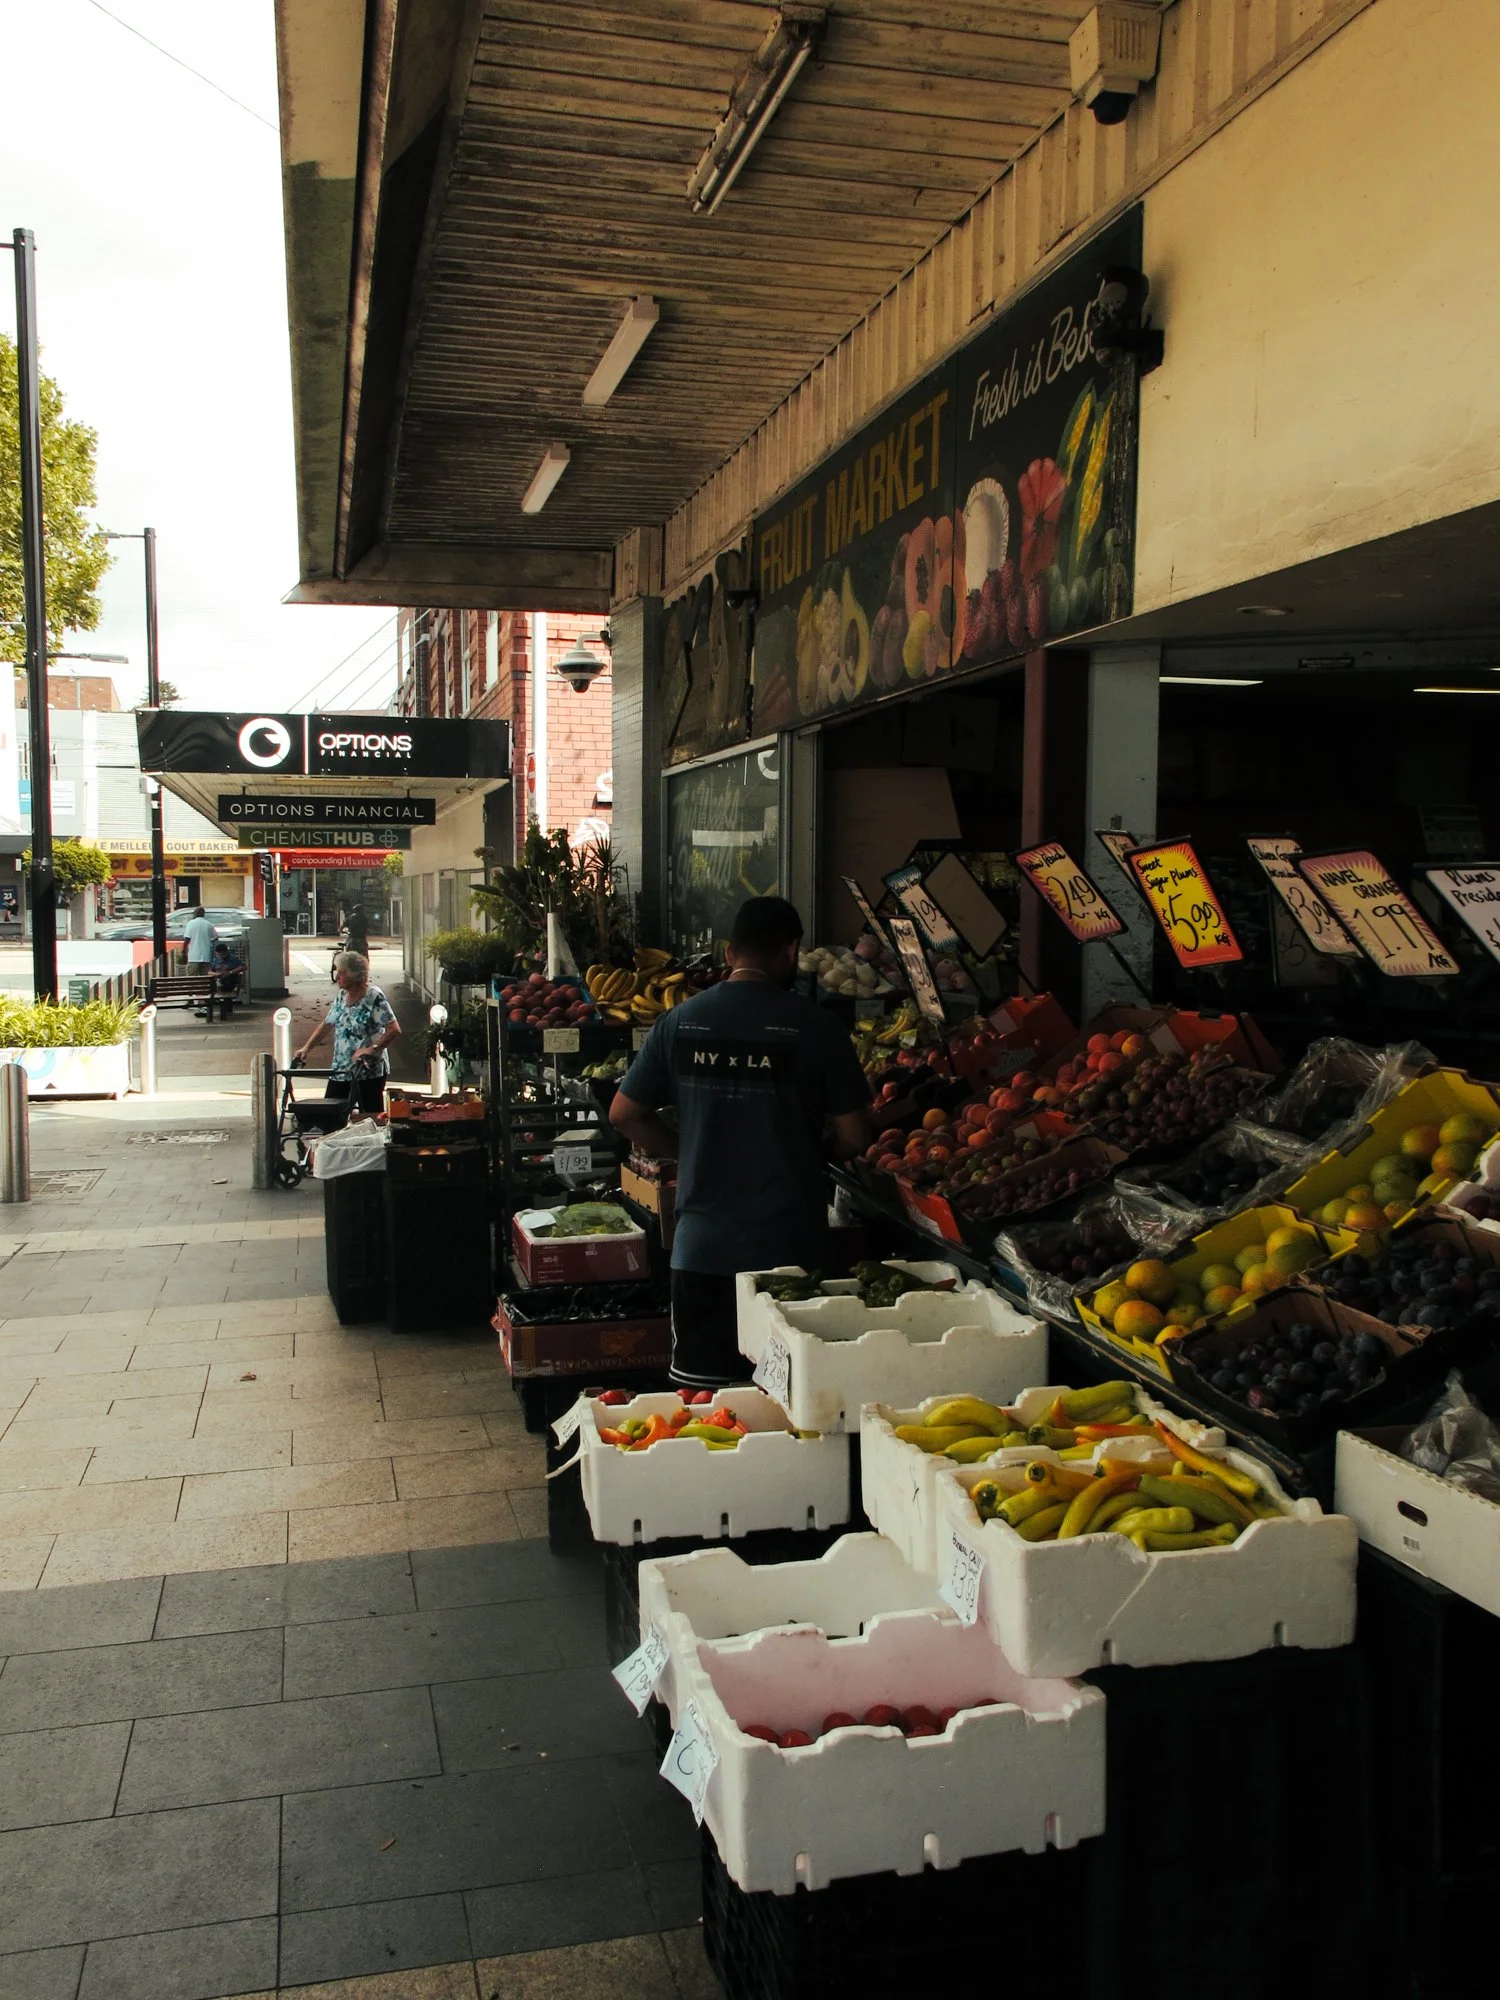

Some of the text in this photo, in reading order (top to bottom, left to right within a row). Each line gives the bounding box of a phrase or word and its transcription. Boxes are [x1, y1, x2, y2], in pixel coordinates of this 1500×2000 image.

[968, 348, 1021, 441] Fresh
[1023, 336, 1046, 400] is
[760, 388, 949, 604] FRUIT MARKET
[318, 733, 412, 751] OPTIONS
[320, 750, 412, 759] FINANCIAL
[229, 803, 425, 818] OPTIONS FINANCIAL
[166, 842, 196, 851] GOUT
[249, 830, 375, 846] CHEMISTHUB
[292, 856, 342, 866] compounding
[1136, 856, 1164, 874] Sweet
[1145, 866, 1199, 893] Sugar Plums
[1318, 869, 1365, 888] NAVEL
[1444, 869, 1496, 887] Plums
[1352, 879, 1402, 899] ORANGE
[1094, 908, 1111, 920] KG
[1160, 893, 1222, 952] $5.99
[1214, 932, 1232, 947] KG
[1353, 903, 1436, 959] 1.99
[694, 1051, 772, 1069] NY x LA
